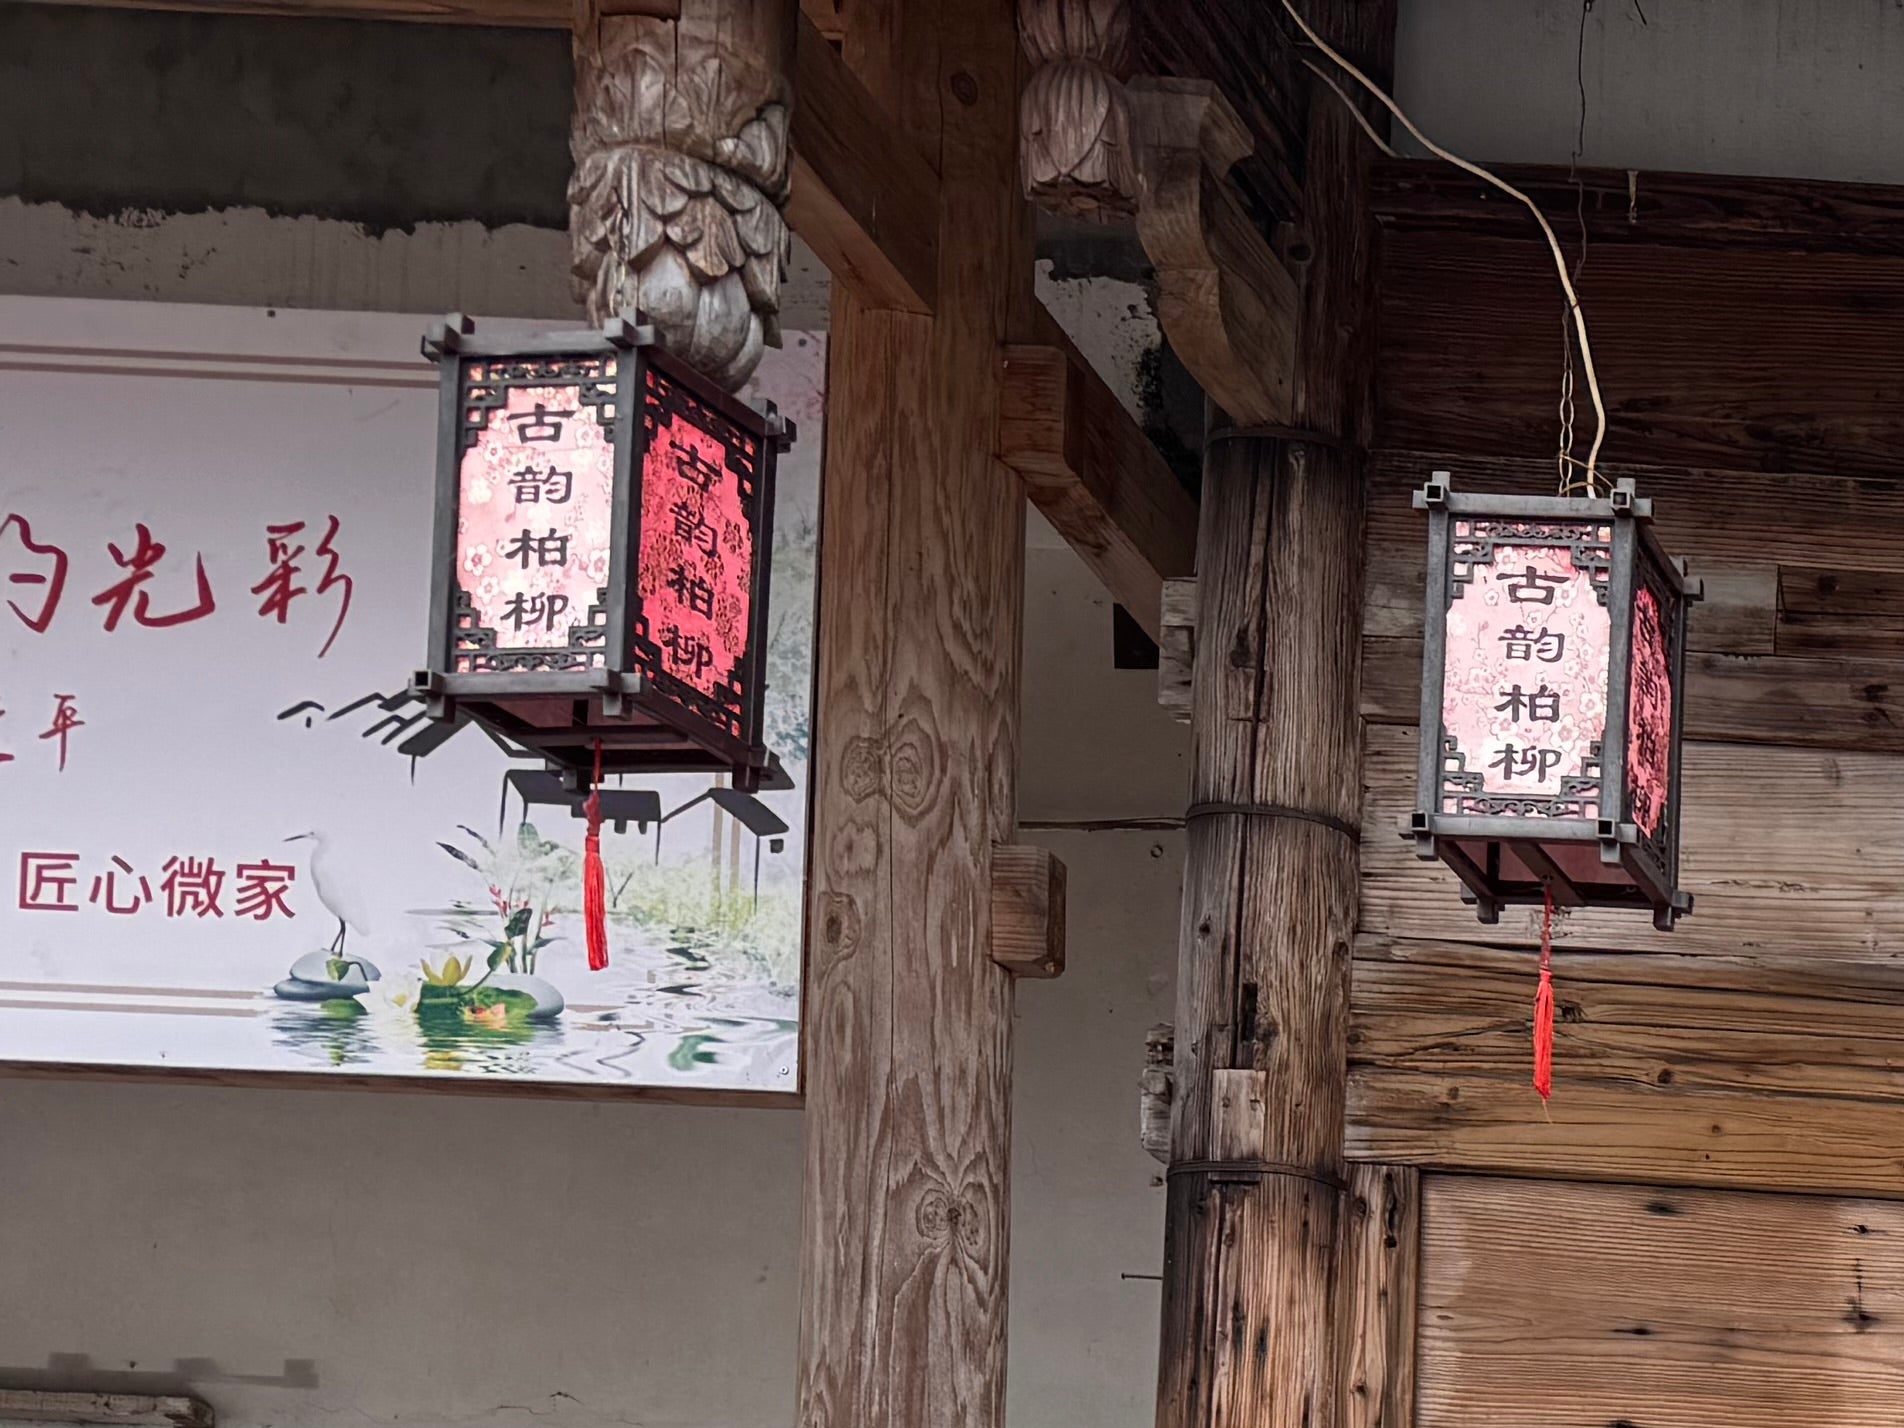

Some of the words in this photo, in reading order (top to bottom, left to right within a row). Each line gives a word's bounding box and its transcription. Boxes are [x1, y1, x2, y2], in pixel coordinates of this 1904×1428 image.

[499, 405, 573, 632] 古韵柏柳
[665, 440, 723, 680] 古韵柏柳
[1488, 566, 1570, 783] 古韵柏柳
[18, 852, 296, 921] 匠心微家
